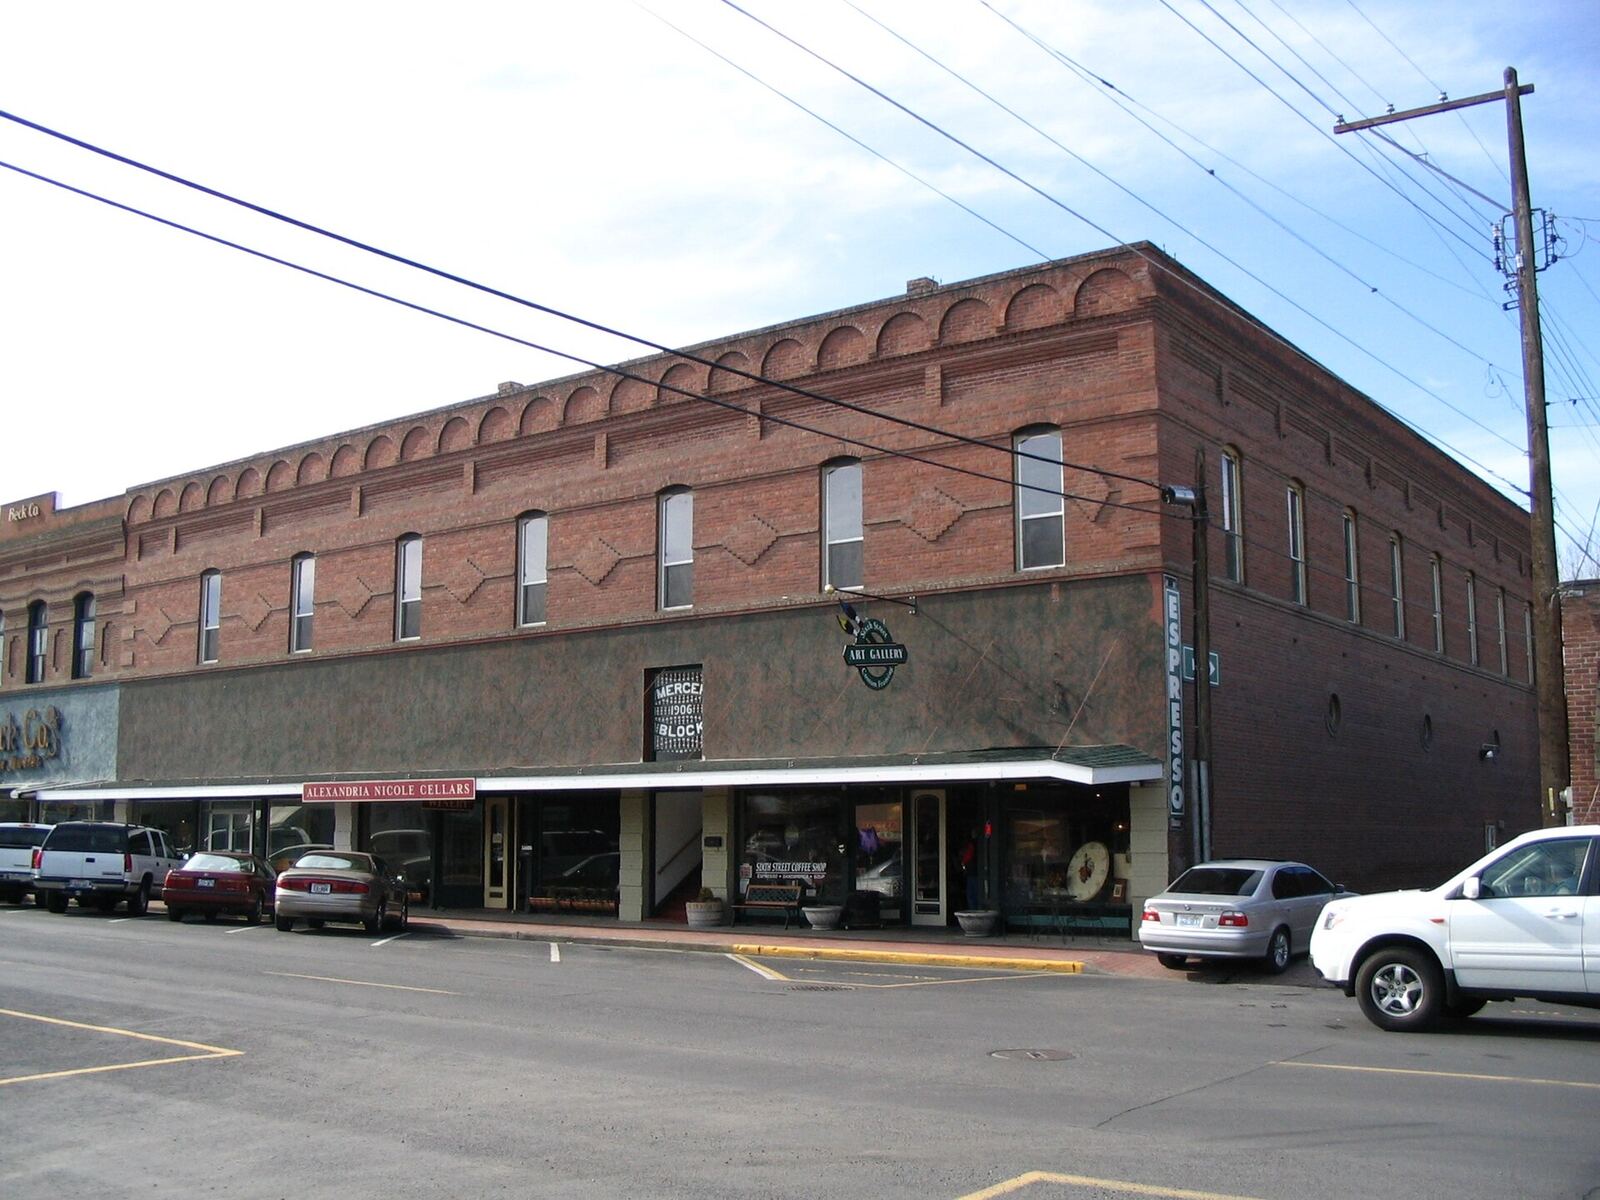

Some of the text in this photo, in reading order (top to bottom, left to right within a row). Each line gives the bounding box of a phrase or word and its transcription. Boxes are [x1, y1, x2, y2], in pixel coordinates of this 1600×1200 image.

[849, 648, 903, 660] ART GALLERY
[1168, 594, 1183, 810] ESPRESSO
[671, 704, 693, 716] 1906
[659, 721, 703, 738] BLOCK
[306, 783, 470, 798] ALEXANDRIA NICOLE CELLARS
[772, 862, 791, 872] STREET
[791, 862, 811, 872] COFFEE
[812, 862, 827, 872] SHOP
